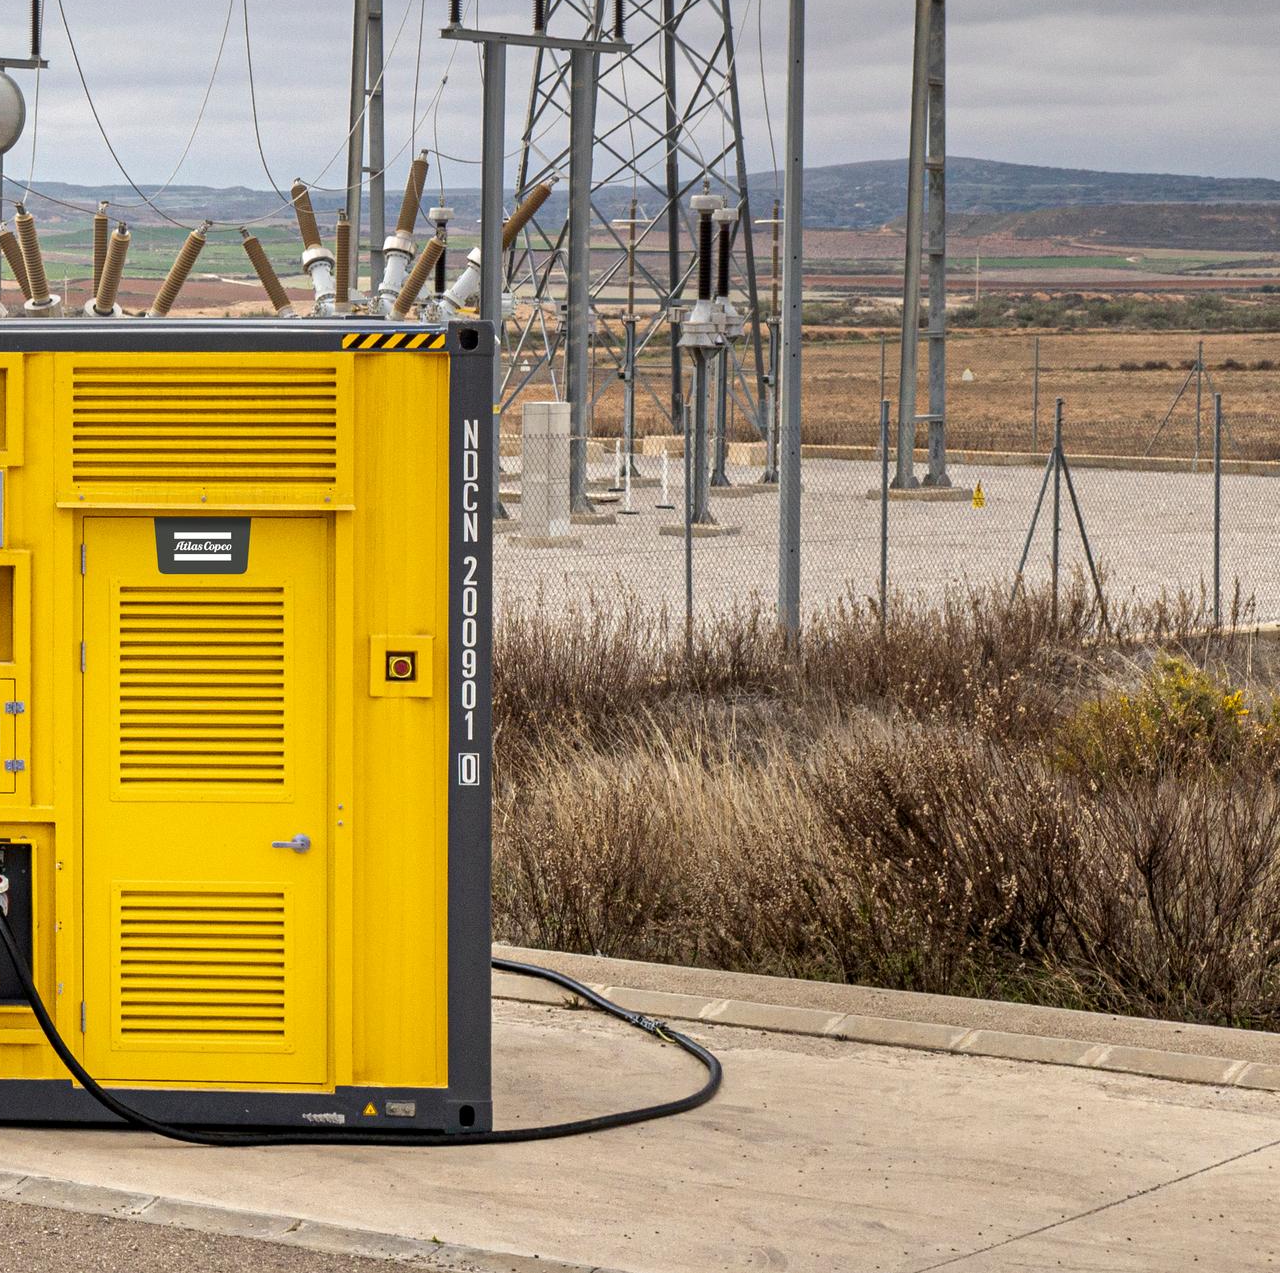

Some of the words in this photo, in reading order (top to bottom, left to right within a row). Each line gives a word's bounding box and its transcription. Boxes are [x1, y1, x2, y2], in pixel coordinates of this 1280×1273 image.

[463, 419, 479, 543] NDCN
[174, 541, 203, 551] Atlas
[203, 541, 232, 553] Copco
[461, 556, 478, 741] 200901
